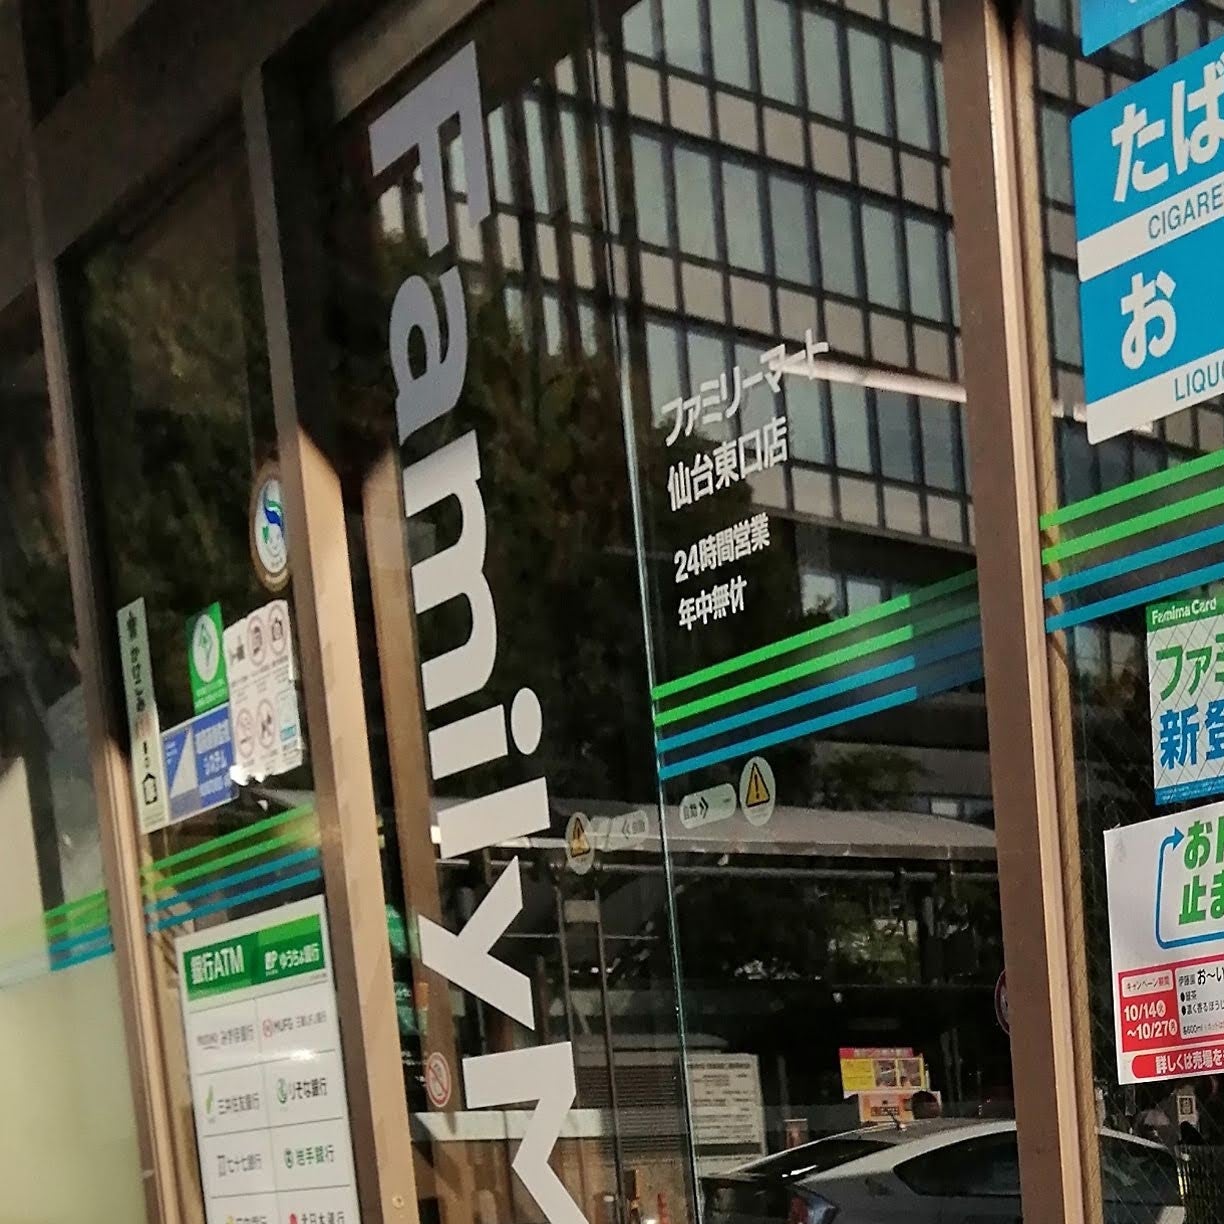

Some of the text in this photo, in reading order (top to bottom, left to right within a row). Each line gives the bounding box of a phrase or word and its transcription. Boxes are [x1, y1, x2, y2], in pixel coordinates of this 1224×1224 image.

[661, 328, 829, 447] ファミリーマート
[667, 416, 788, 512] 仙台東口店
[674, 512, 770, 583] 24時間営業
[678, 575, 747, 631] 年中無休
[1152, 598, 1217, 625] Famima Card
[190, 945, 245, 985] 銀行ATM
